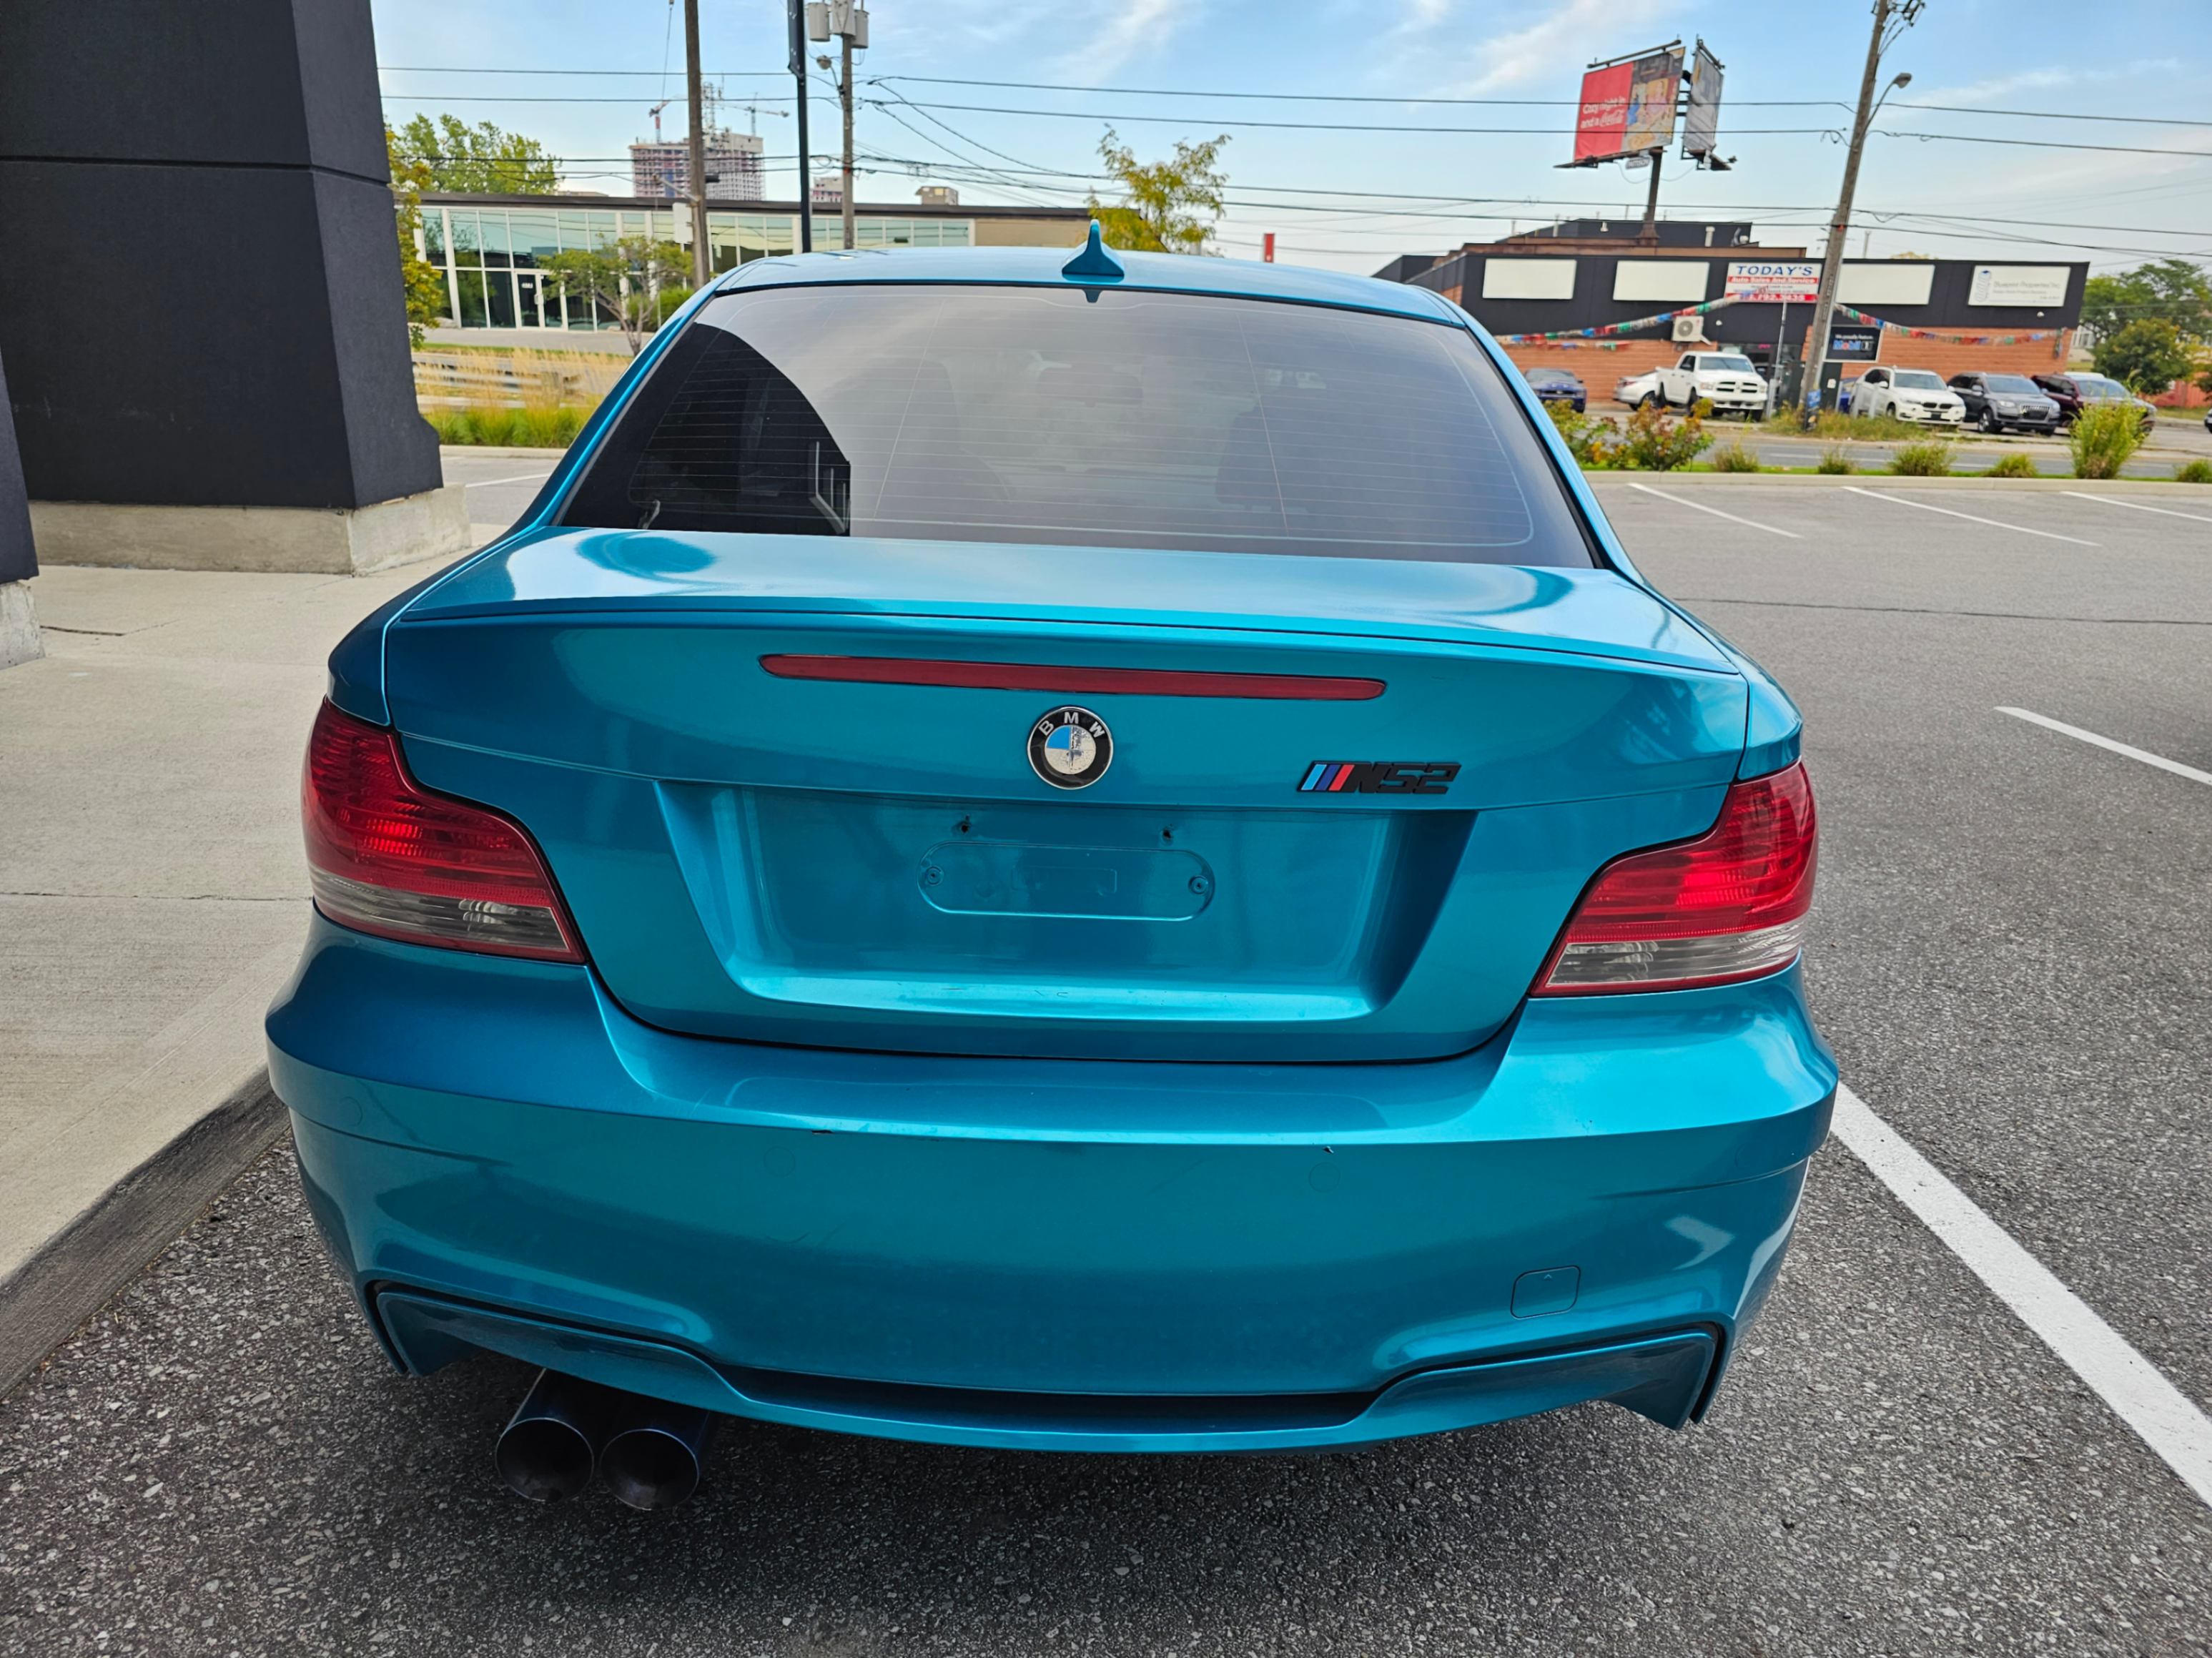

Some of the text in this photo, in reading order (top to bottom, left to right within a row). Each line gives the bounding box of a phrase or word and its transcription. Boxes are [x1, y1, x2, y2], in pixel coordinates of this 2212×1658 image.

[1737, 265, 1813, 276] TODAY'S
[1832, 340, 1861, 350] Mobil
[1038, 711, 1105, 738] BMW
